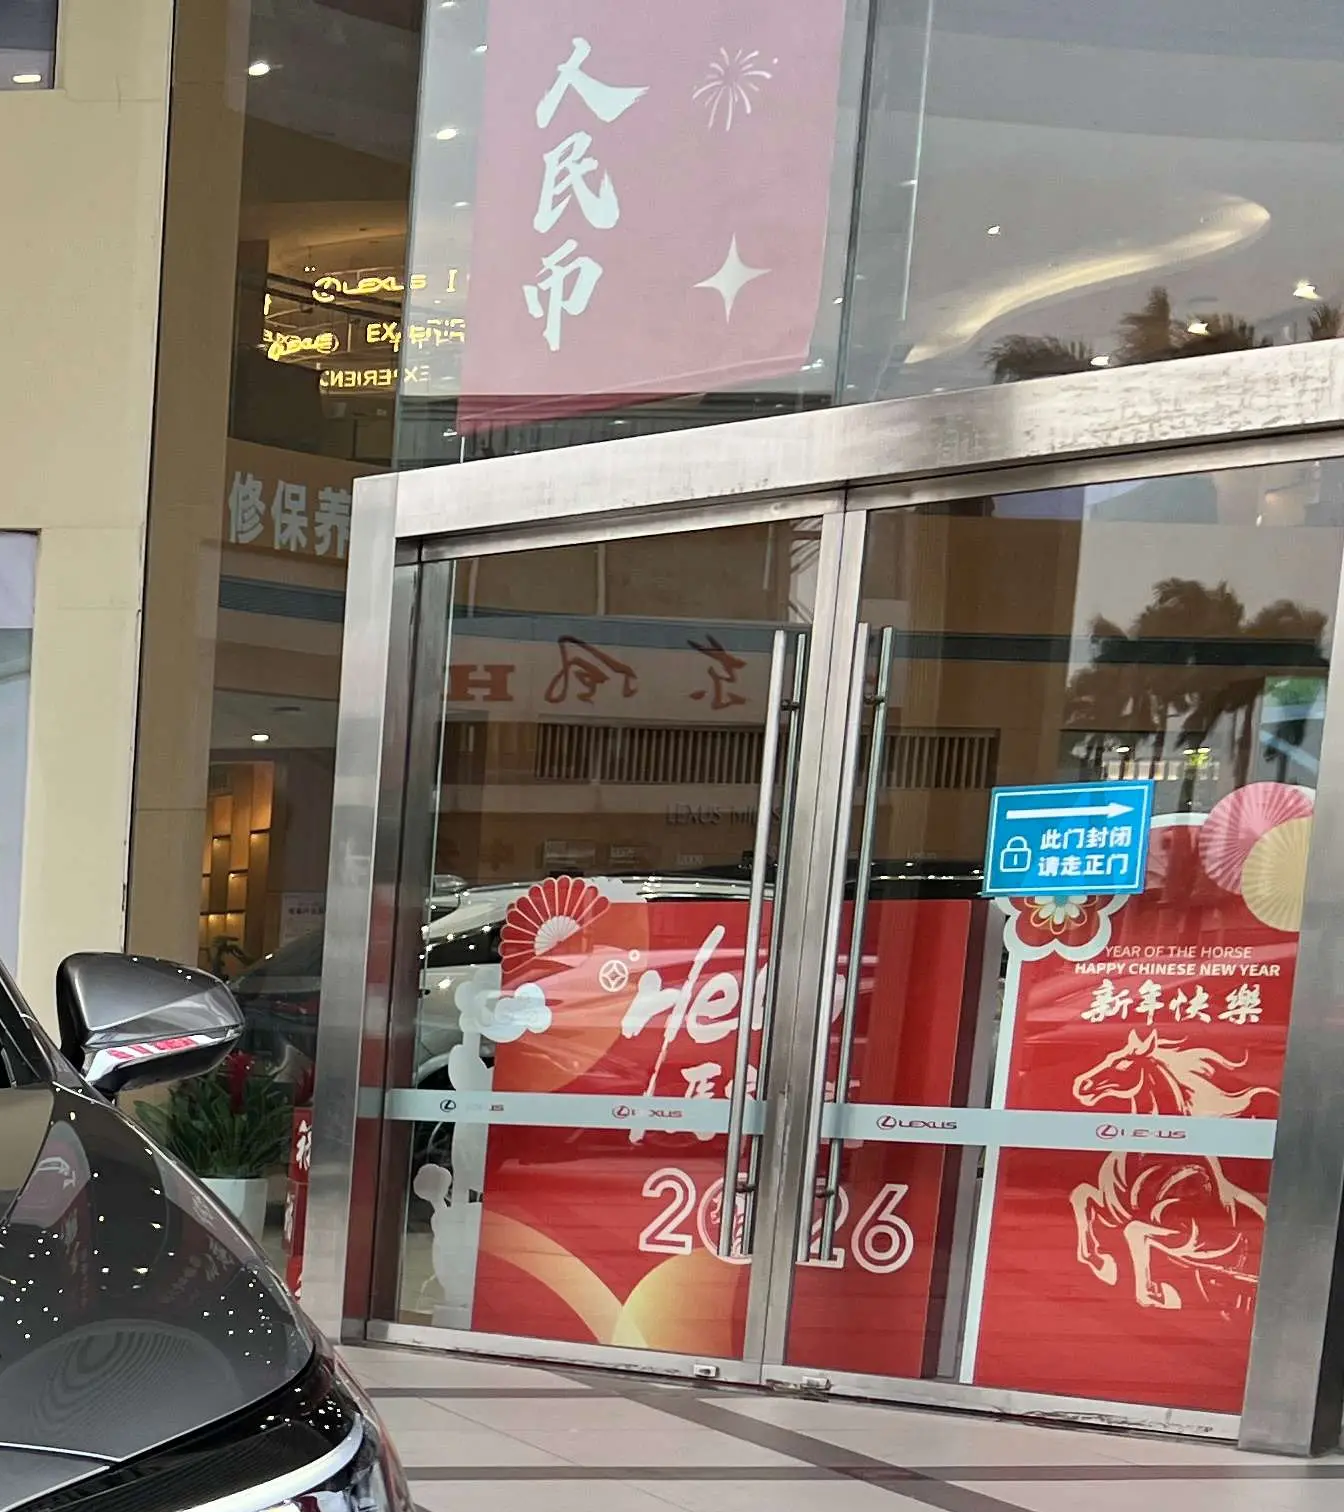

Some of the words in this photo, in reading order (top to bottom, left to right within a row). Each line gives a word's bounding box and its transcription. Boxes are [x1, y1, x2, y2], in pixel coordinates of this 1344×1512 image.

[520, 36, 650, 352] 人民币
[1039, 826, 1133, 851] 此门封闭
[1037, 853, 1129, 878] 请走正门
[1105, 945, 1142, 960] YEAR
[1145, 945, 1166, 959] OF
[1167, 945, 1198, 959] THE
[1200, 945, 1254, 960] HORSE
[1074, 962, 1126, 976] HAPPY
[1128, 963, 1197, 977] CHINESE
[1199, 963, 1238, 977] NEW
[1239, 964, 1281, 978] YEAR
[898, 1119, 958, 1131] LEXUS
